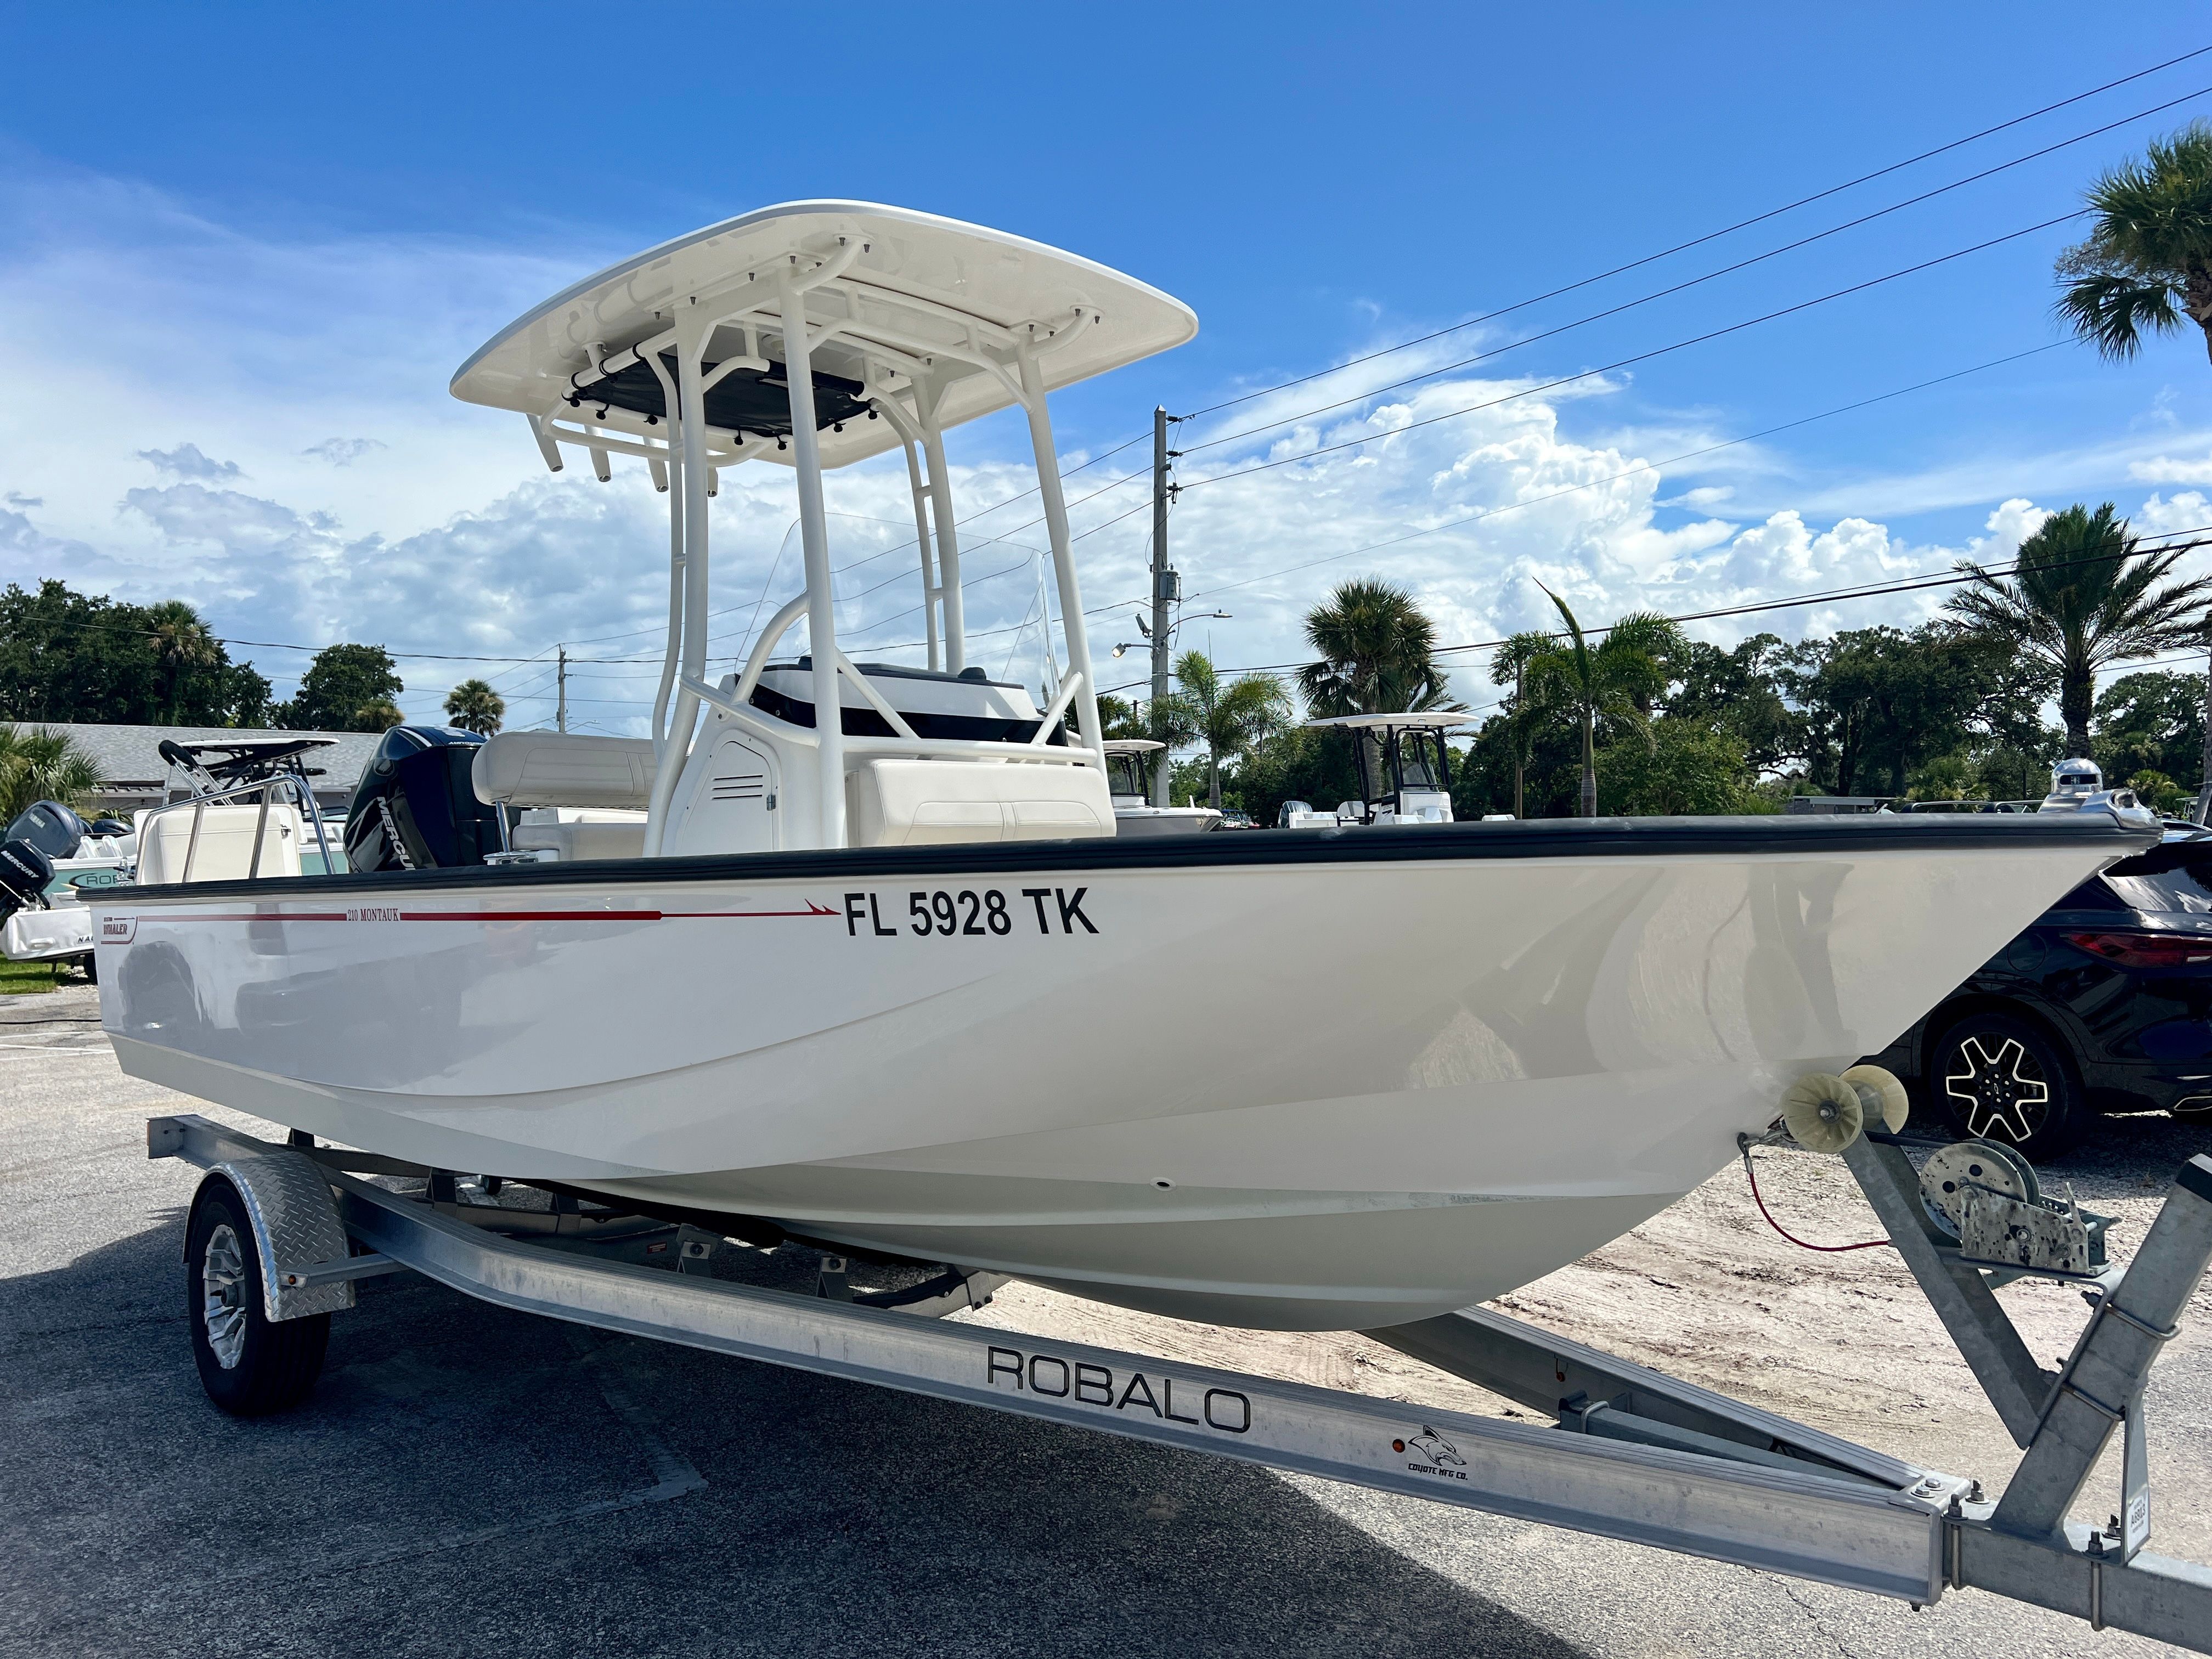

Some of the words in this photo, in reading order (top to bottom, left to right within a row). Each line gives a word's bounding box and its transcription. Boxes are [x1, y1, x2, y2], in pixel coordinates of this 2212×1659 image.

[1, 850, 39, 878] MERCURY
[348, 909, 358, 921] 210
[360, 908, 399, 921] MONTAUK
[844, 893, 898, 936] FL
[910, 889, 1012, 936] 5928
[1022, 887, 1100, 934] TK
[103, 924, 128, 935] WHALER
[988, 1346, 1251, 1434] ROBALO
[1408, 1463, 1437, 1475] COYOTE
[1439, 1468, 1455, 1477] MFG
